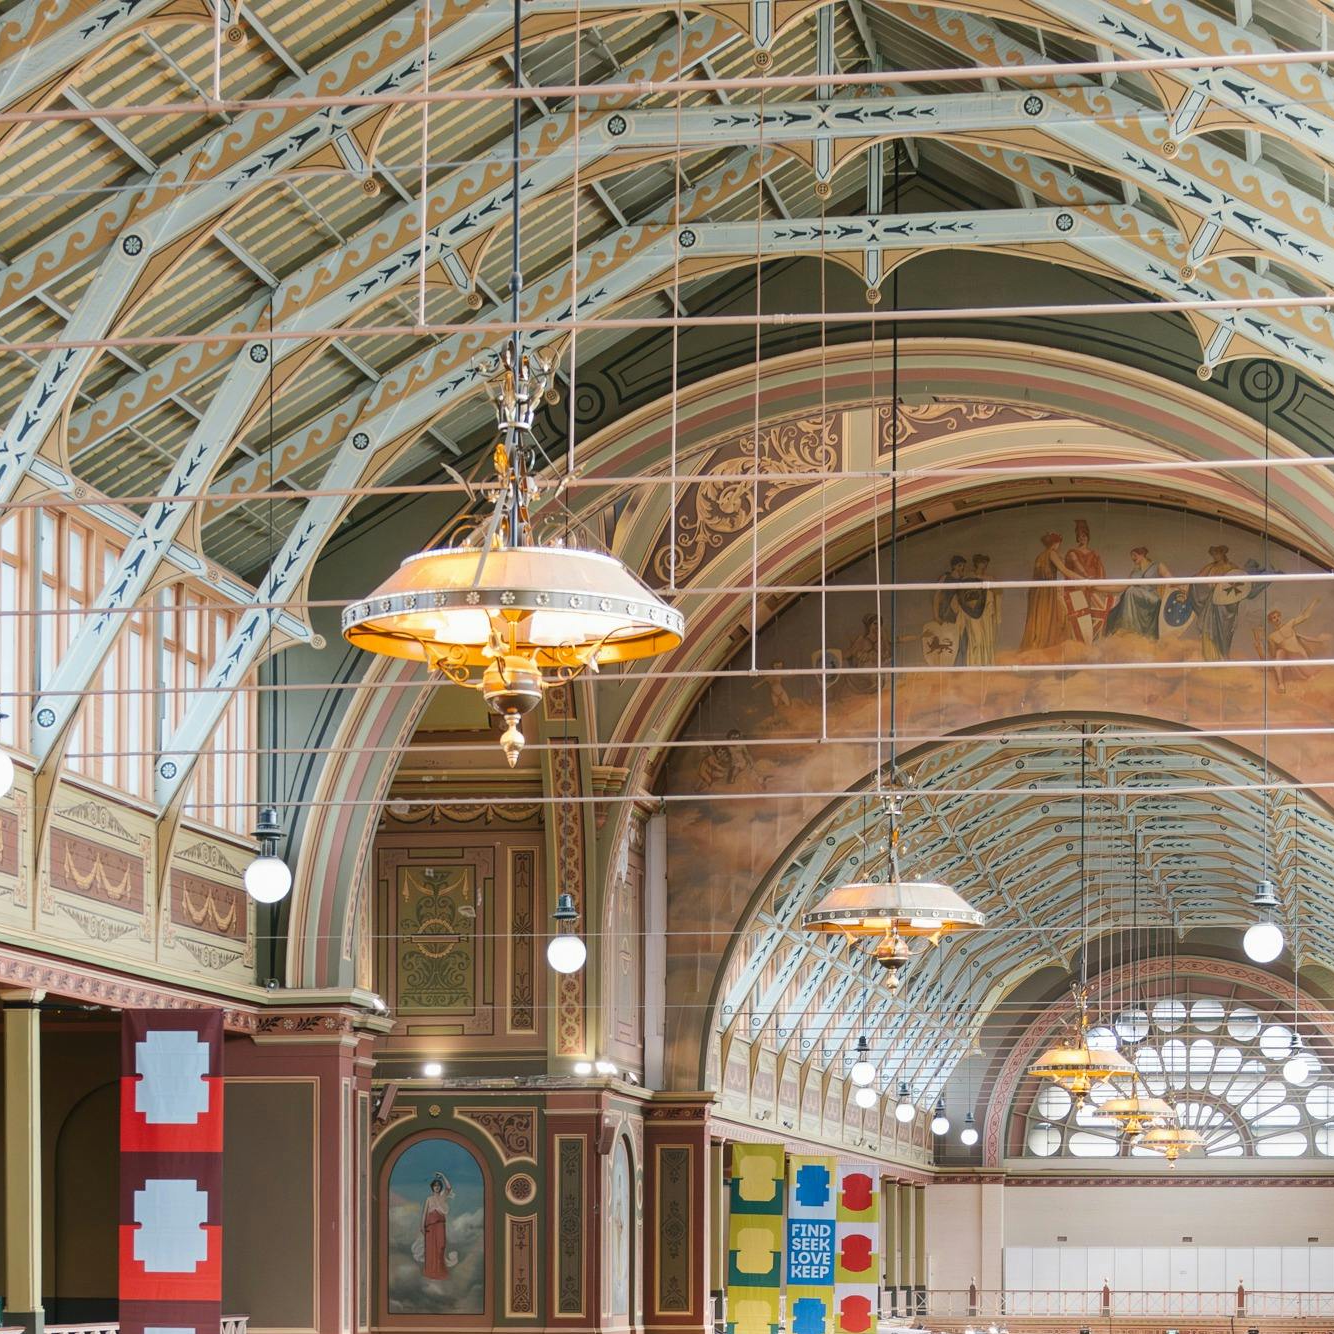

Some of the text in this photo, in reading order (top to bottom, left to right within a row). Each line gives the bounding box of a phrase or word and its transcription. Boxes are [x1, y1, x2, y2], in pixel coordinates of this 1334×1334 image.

[791, 1223, 831, 1237] FIND
[791, 1238, 830, 1251] SEEK
[790, 1251, 831, 1264] LOVE
[791, 1265, 830, 1278] KEEP
